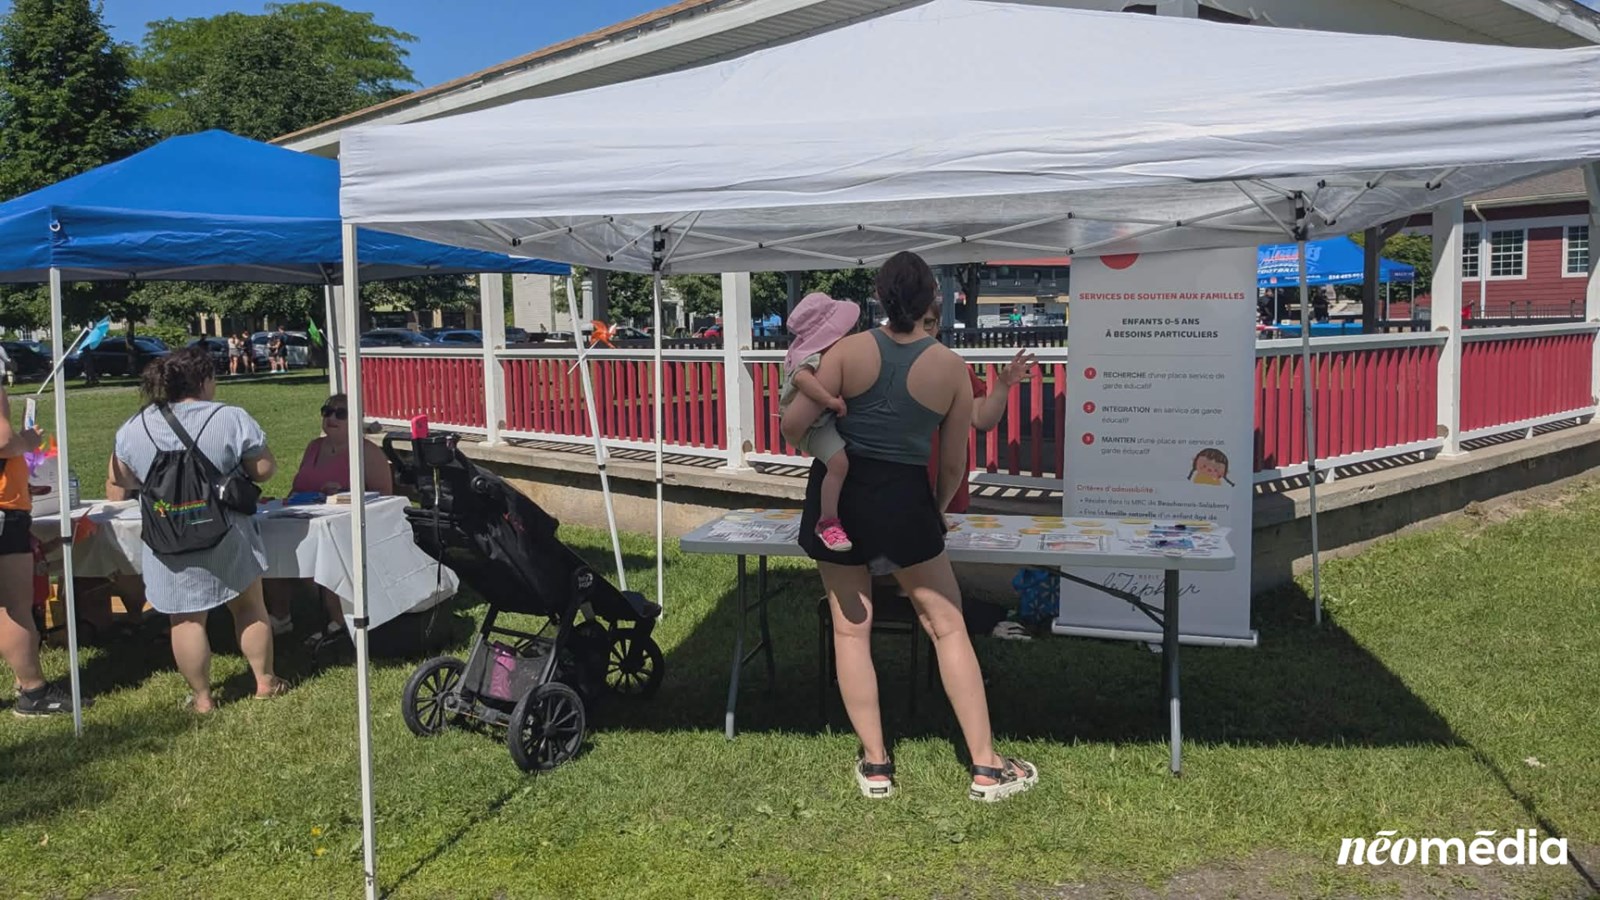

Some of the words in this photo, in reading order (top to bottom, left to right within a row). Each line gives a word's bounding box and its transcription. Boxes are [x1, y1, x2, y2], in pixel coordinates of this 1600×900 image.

[1079, 293, 1121, 301] SERVICES
[1137, 292, 1177, 301] SOUTIEN
[1179, 292, 1198, 300] AUX
[1200, 292, 1245, 300] FAMILLES
[1105, 330, 1112, 338] À
[1103, 371, 1146, 379] RECHERCHE
[1167, 371, 1187, 381] place
[1189, 372, 1214, 380] service
[1215, 372, 1225, 380] de
[1102, 383, 1122, 391] garde
[1201, 407, 1222, 416] garde
[1102, 436, 1136, 444] MAINTIEN
[1157, 437, 1176, 446] place
[1188, 438, 1214, 446] service
[1215, 438, 1225, 446] de
[1101, 448, 1121, 456] garde
[1077, 484, 1103, 492] Critères
[1105, 509, 1126, 517] famille
[1128, 510, 1156, 518] naturelle
[1172, 511, 1192, 520] enfant
